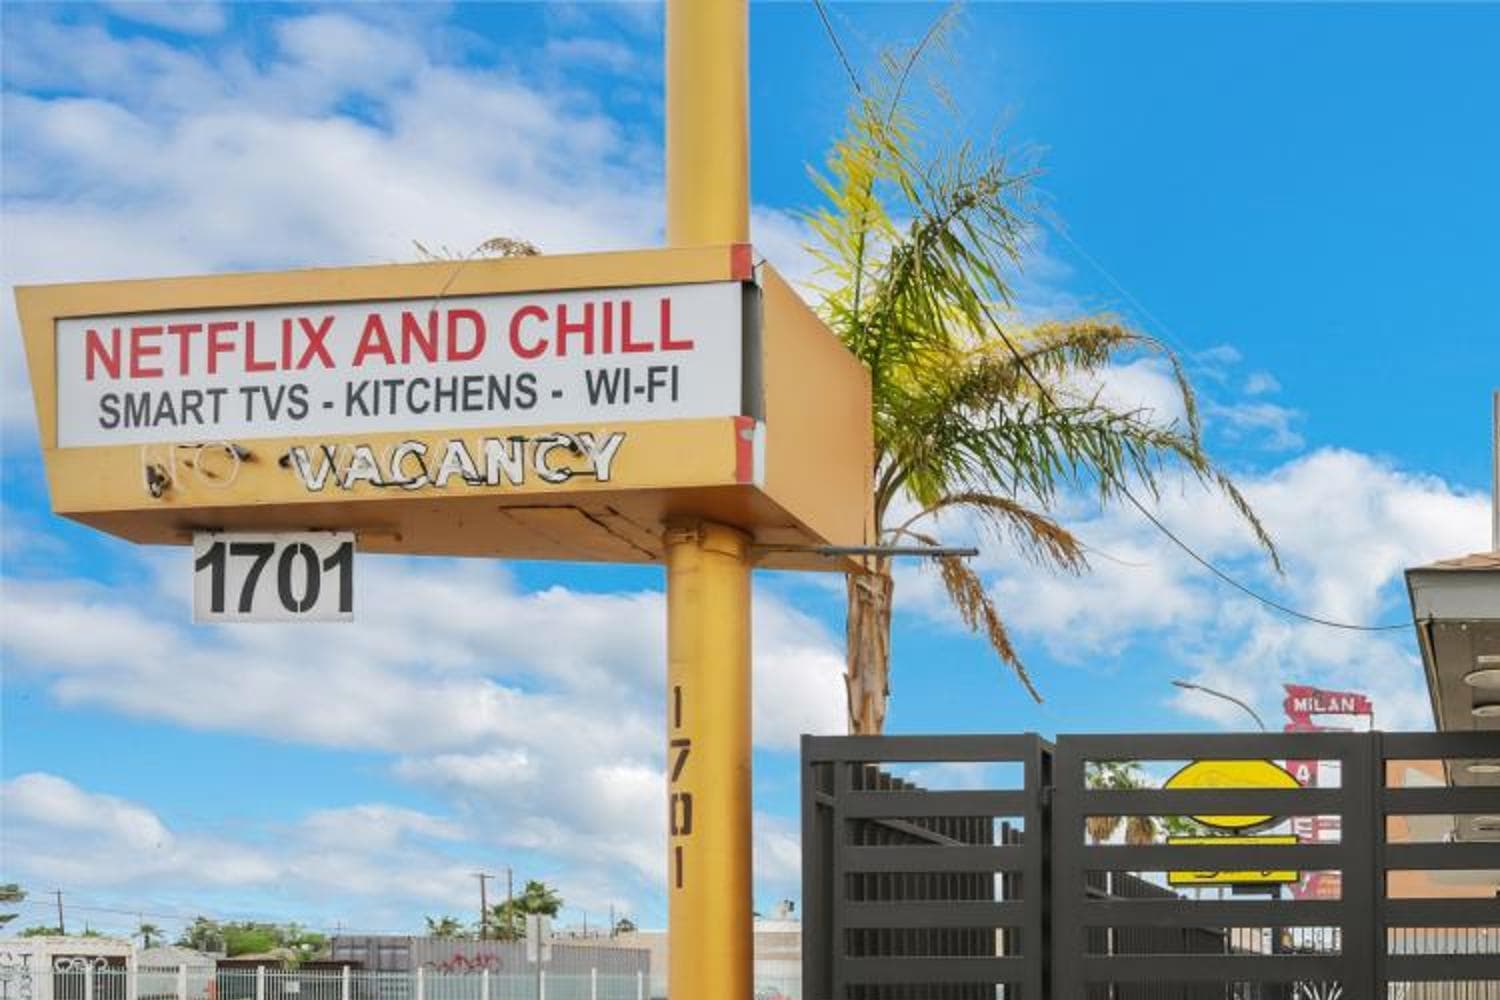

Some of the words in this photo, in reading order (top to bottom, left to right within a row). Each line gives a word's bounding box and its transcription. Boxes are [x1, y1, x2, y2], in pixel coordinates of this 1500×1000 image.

[85, 316, 336, 381] NETFLIX
[351, 309, 487, 367] AND
[508, 298, 695, 360] CHILL
[98, 388, 228, 430] SMART
[239, 383, 310, 422] TVS
[345, 372, 538, 418] KITCHENS
[585, 364, 680, 406] WI-FI
[291, 432, 627, 492] VACANCY
[194, 540, 354, 614] 1701
[670, 684, 693, 890] 1701
